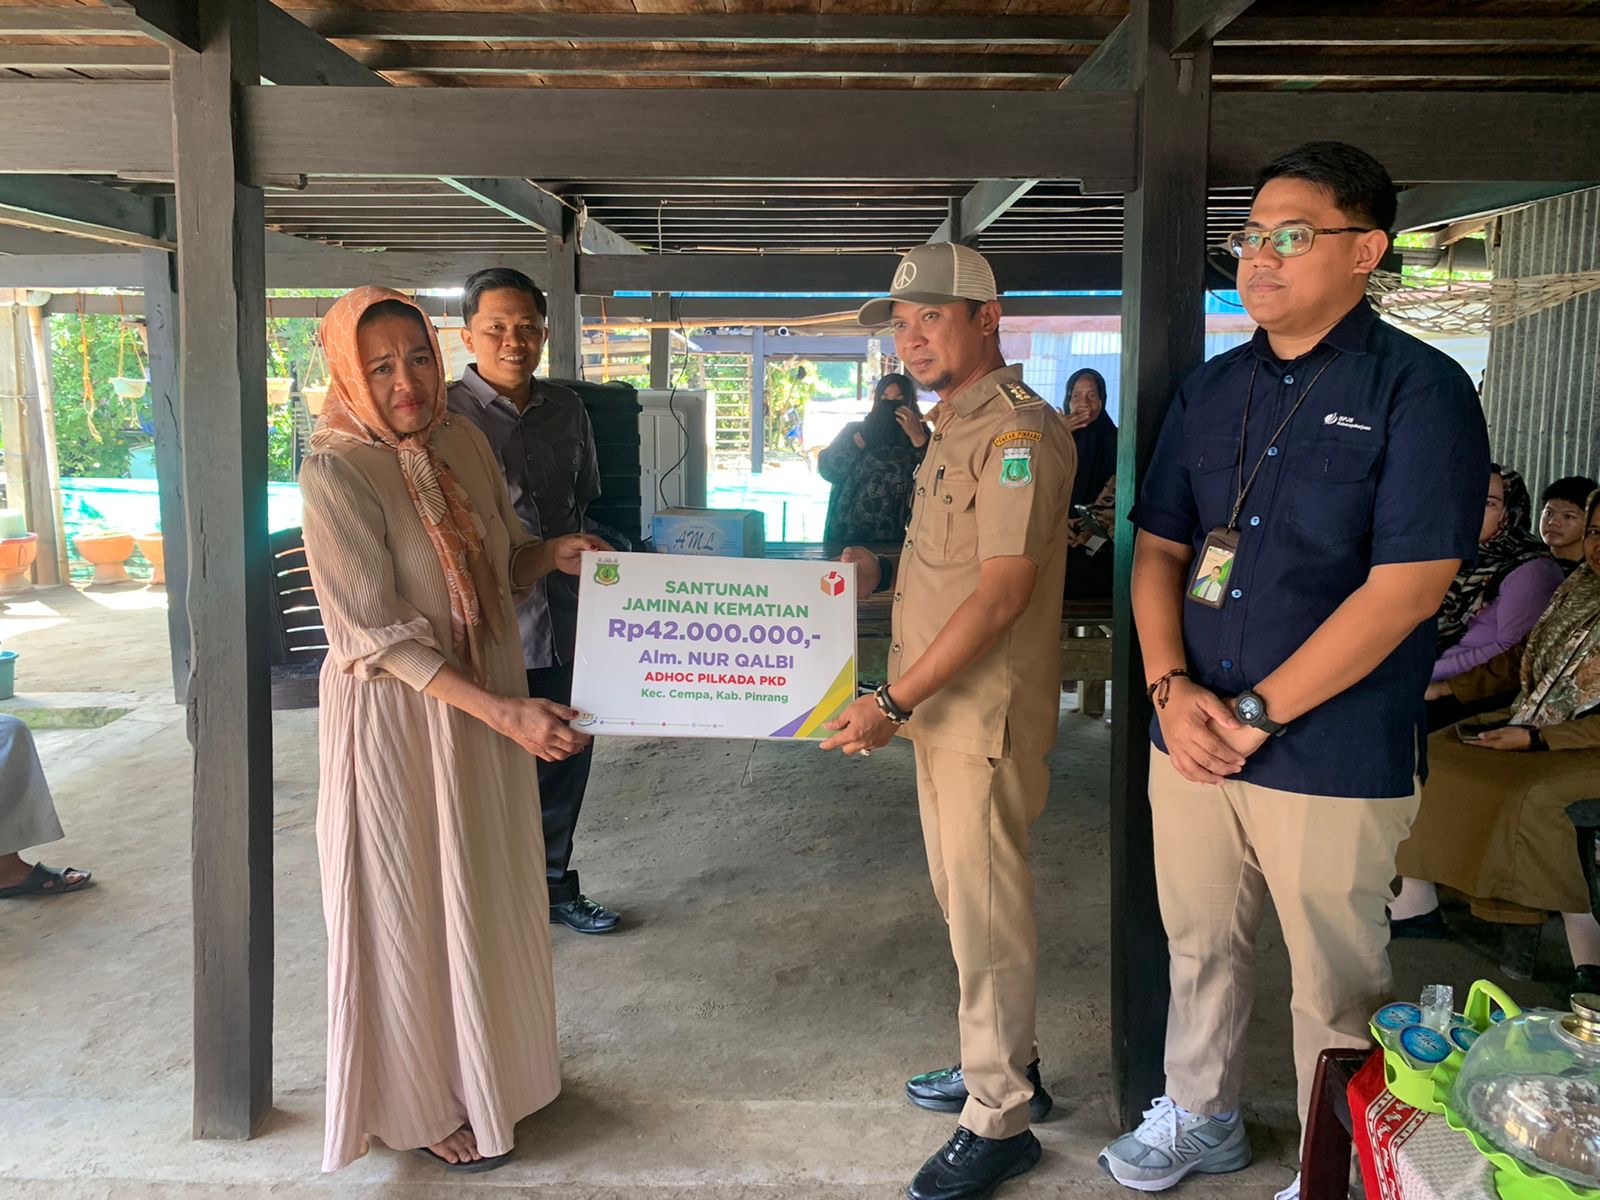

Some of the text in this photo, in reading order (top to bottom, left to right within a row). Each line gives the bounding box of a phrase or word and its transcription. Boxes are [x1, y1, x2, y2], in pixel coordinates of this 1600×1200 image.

[665, 580, 769, 598] SANTUNAN
[622, 598, 809, 618] JAMINAN KEMATIAN
[608, 618, 821, 649] Rp42.000.000,-
[638, 649, 794, 669] Alm. NUR QALBI
[644, 672, 786, 686] ADHOC PILKADA PKD
[641, 688, 789, 704] Kec. Cempa, Kab. Pinrang
